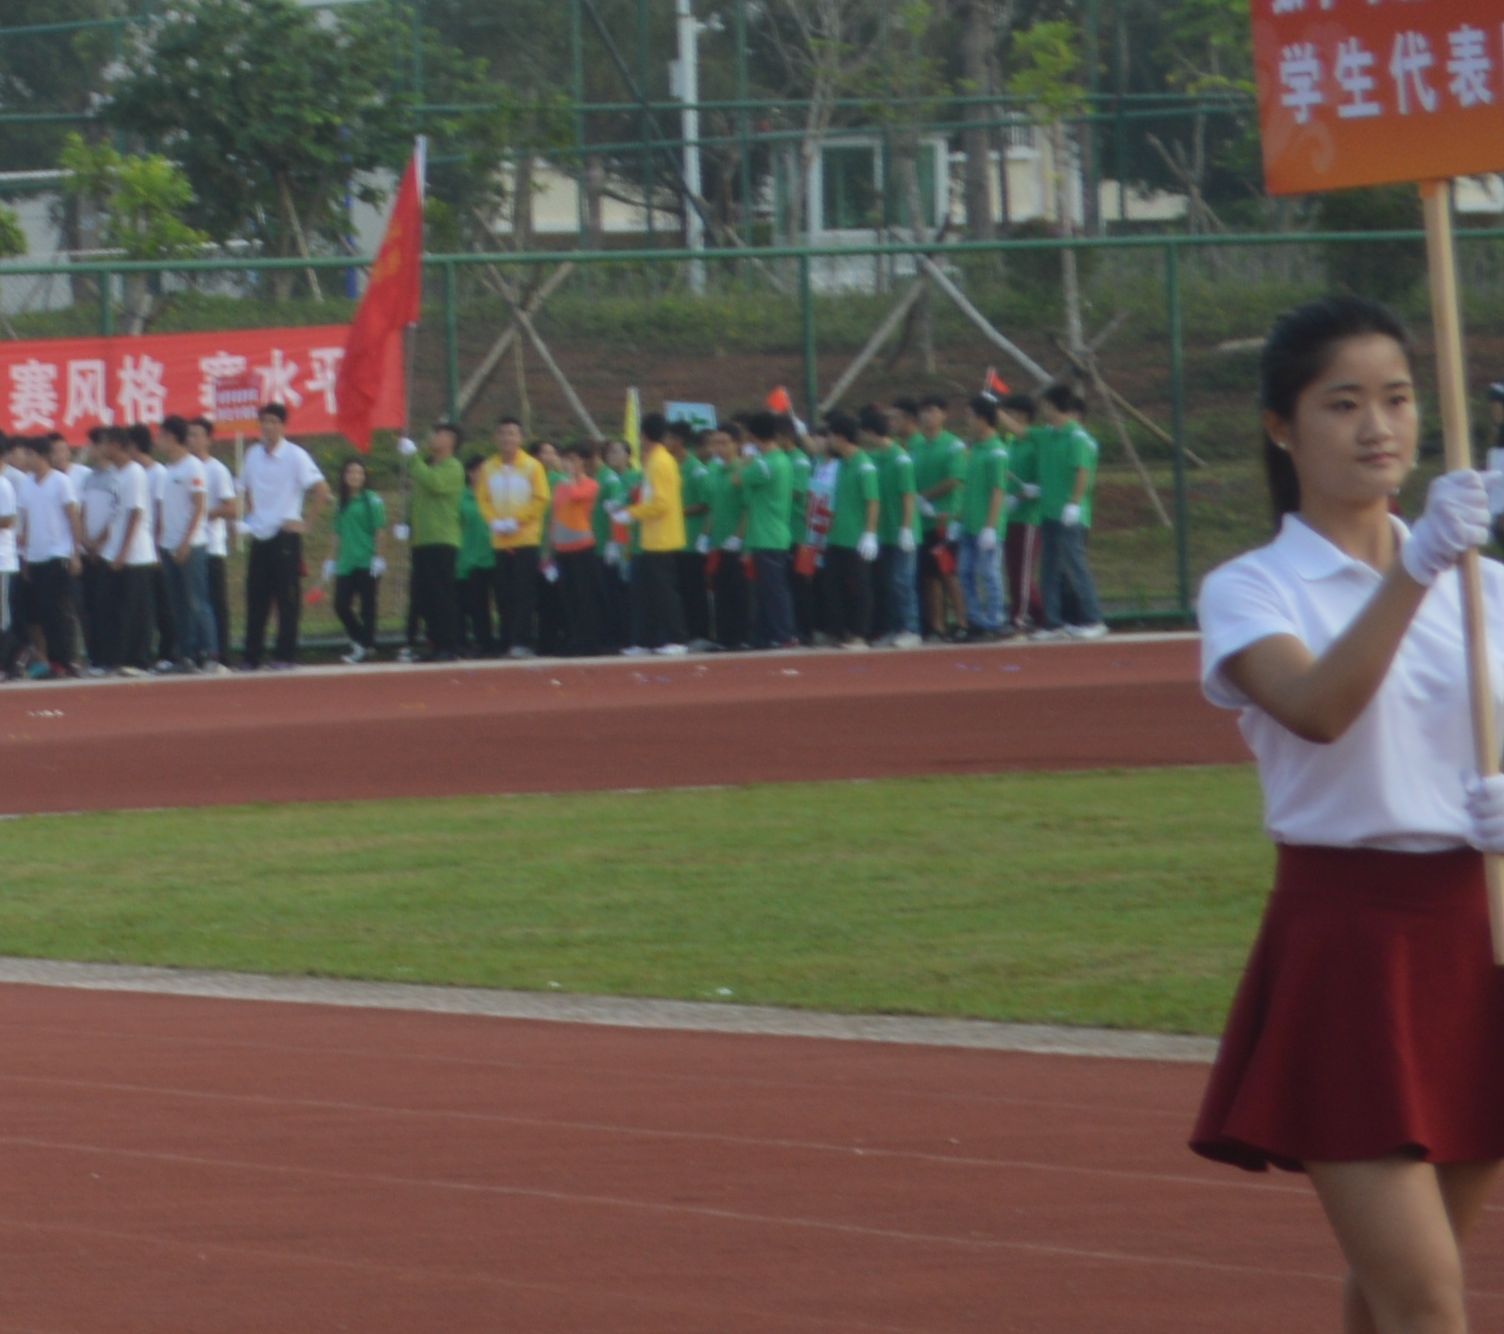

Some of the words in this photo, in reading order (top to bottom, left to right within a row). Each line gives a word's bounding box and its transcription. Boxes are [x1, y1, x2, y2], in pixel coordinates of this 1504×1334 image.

[1279, 22, 1504, 125] 学生代表
[10, 354, 168, 429] 赛风格
